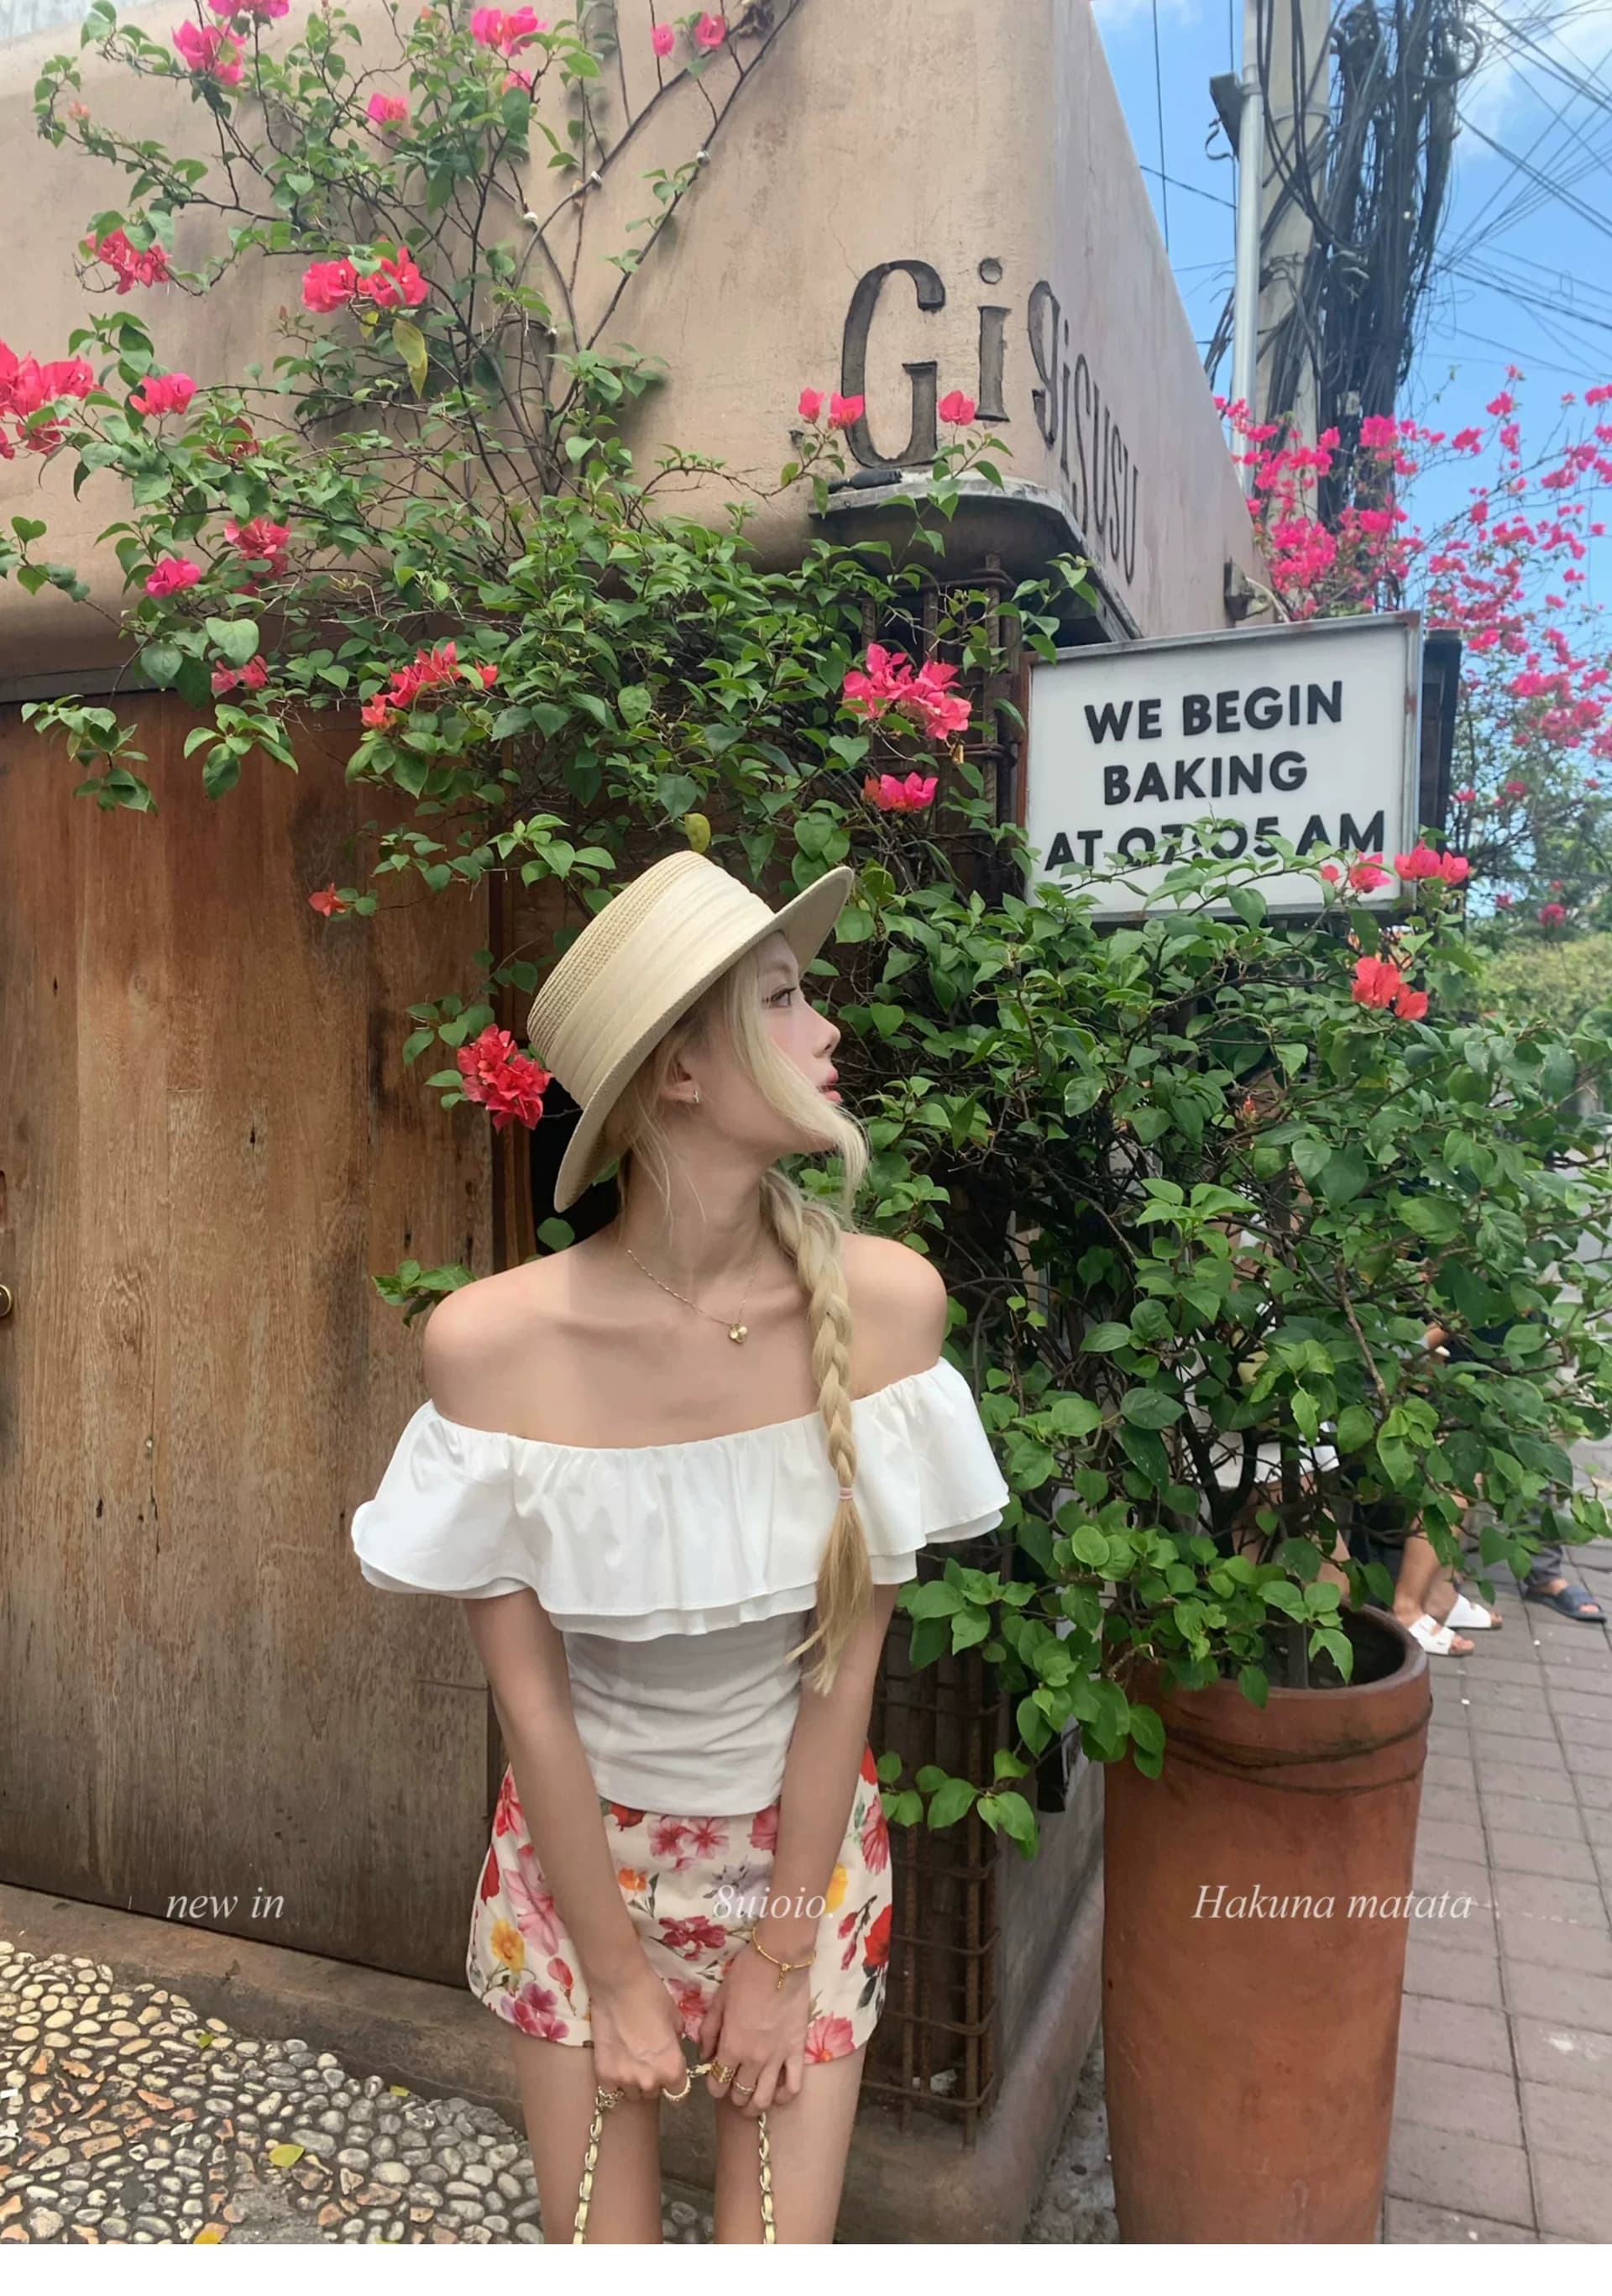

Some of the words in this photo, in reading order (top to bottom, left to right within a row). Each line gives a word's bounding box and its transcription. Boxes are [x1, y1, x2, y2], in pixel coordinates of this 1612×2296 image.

[1084, 699, 1162, 744] WE
[1182, 680, 1342, 737] BEGIN
[1104, 751, 1308, 805] BAKING
[1044, 829, 1103, 872] AT
[1295, 810, 1384, 857] AM
